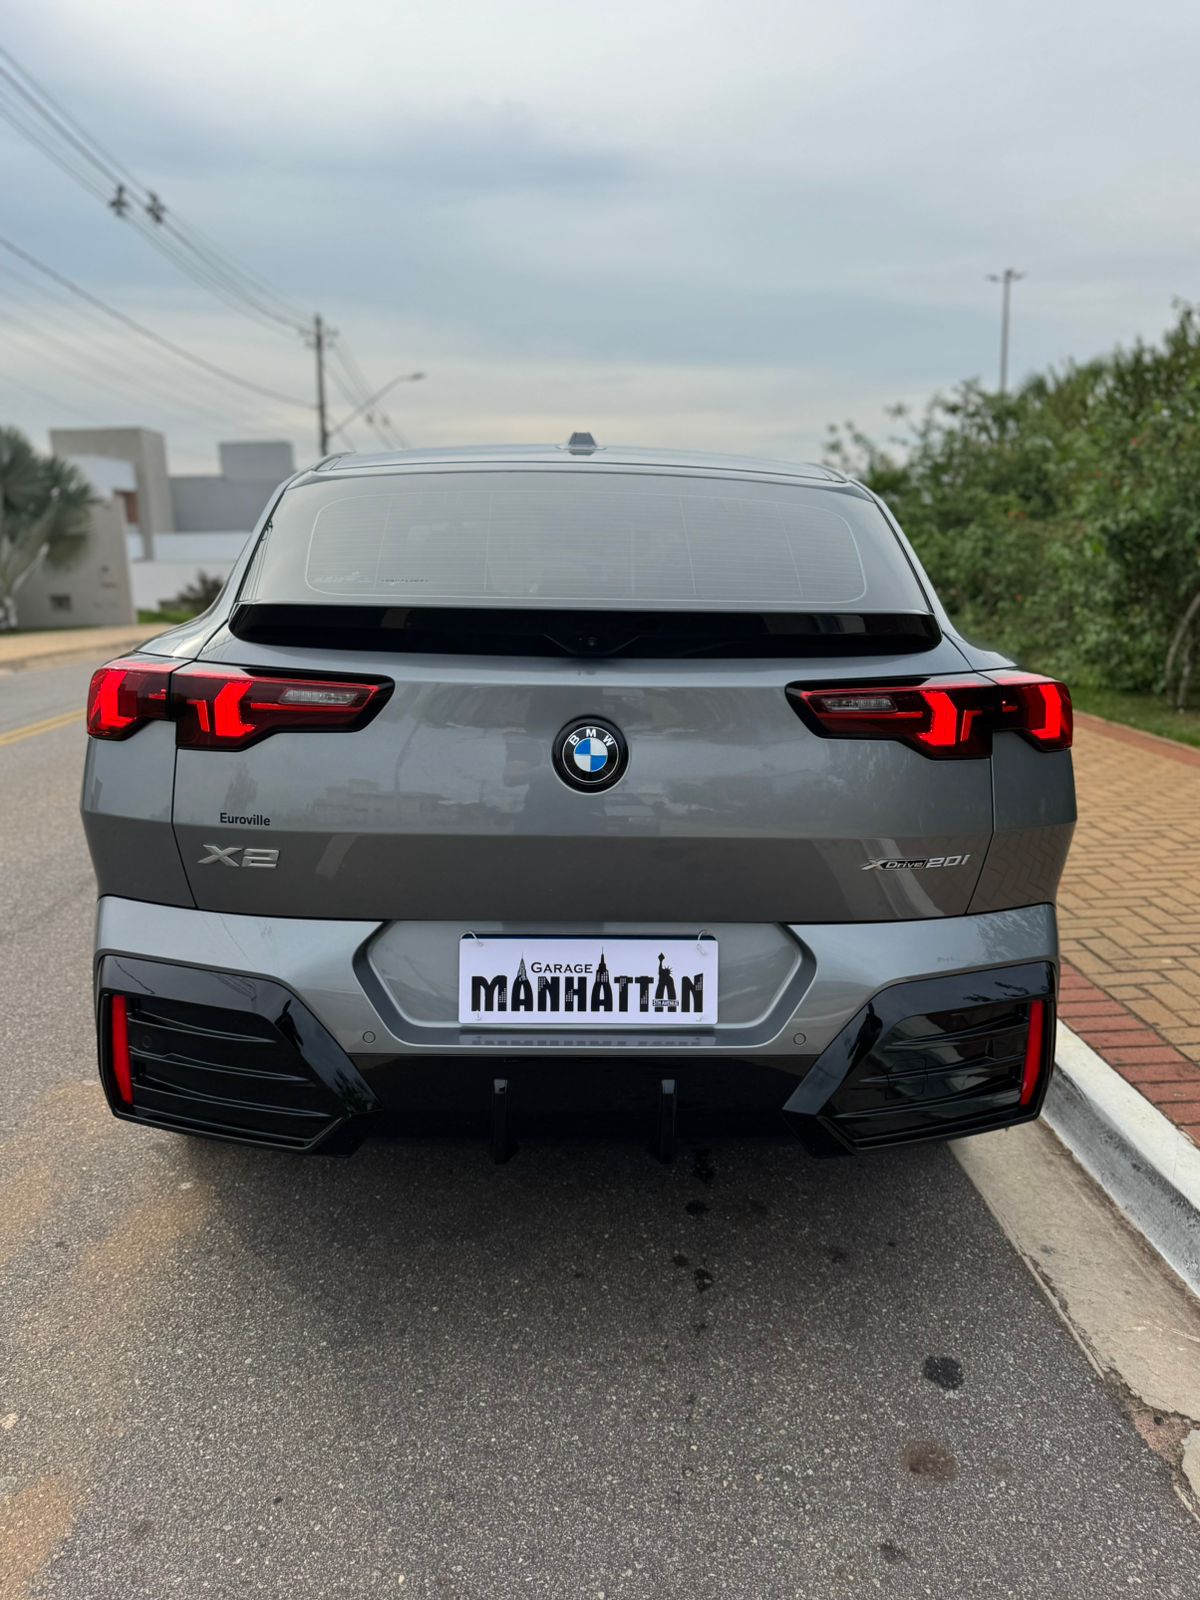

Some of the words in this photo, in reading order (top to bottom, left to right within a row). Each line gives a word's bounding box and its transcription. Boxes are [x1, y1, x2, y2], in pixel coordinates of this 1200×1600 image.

[568, 728, 615, 747] BMW
[219, 812, 271, 827] Euroville
[197, 844, 280, 868] X2
[530, 961, 593, 974] GARAGE
[471, 970, 704, 1013] MANHATTAN
